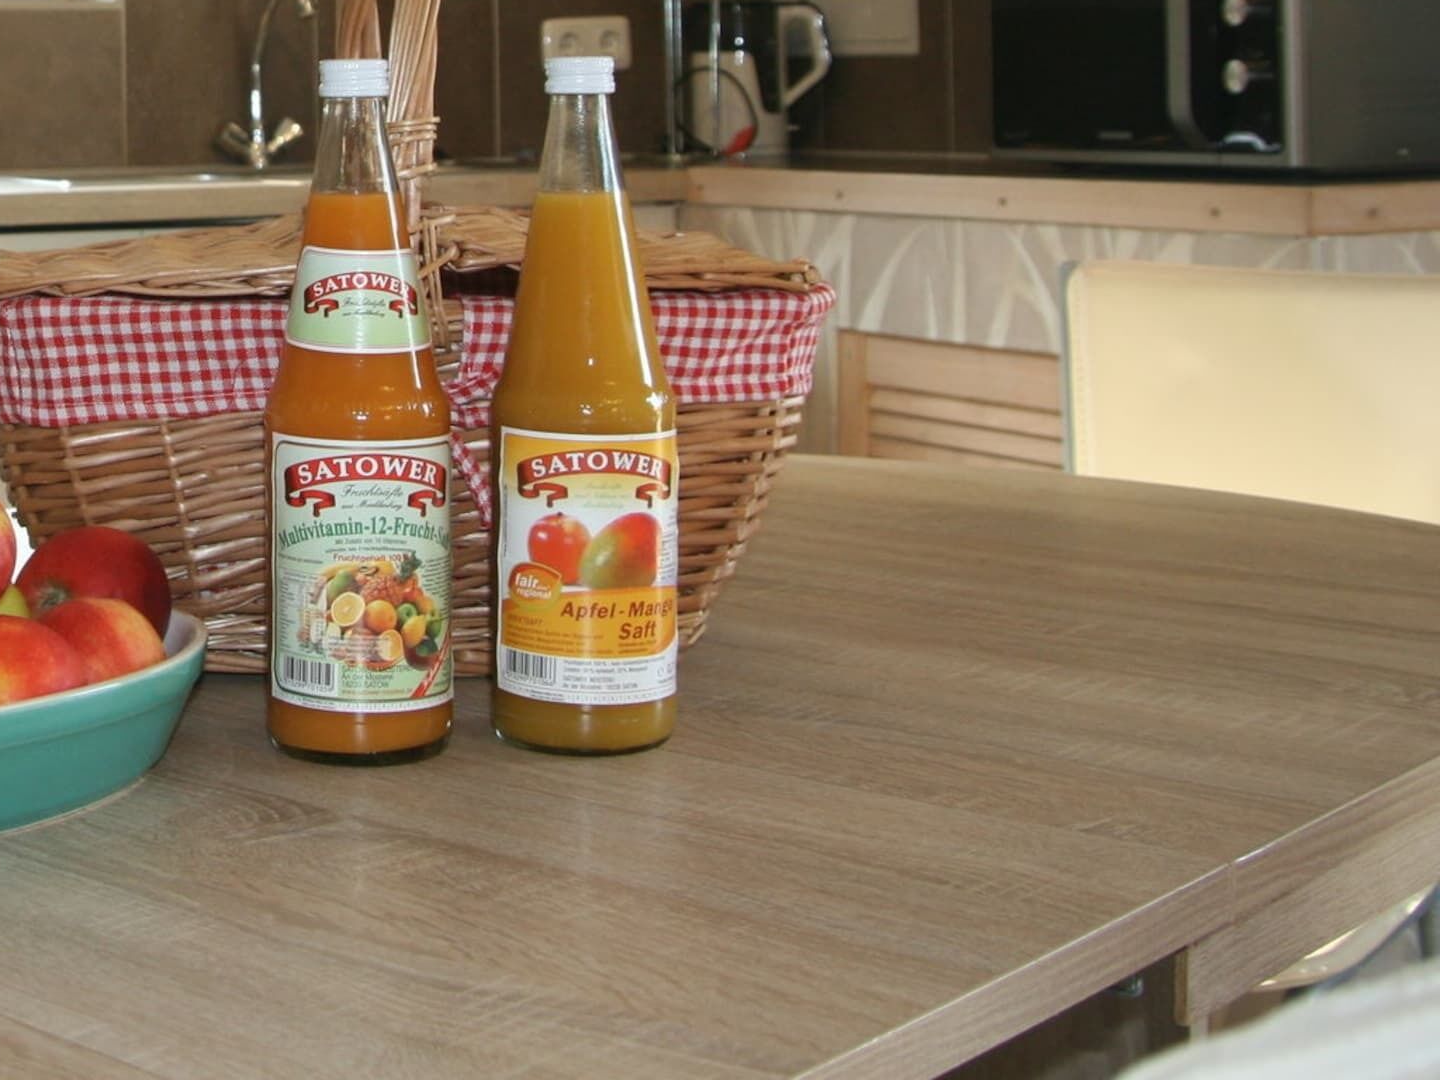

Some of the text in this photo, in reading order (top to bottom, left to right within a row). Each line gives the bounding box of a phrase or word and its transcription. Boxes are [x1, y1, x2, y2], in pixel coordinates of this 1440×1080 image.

[312, 273, 410, 298] SATOWER
[297, 456, 437, 485] SATOWER
[532, 451, 664, 478] SATOWER
[515, 572, 539, 589] fair
[561, 601, 616, 621] Apfel
[618, 620, 657, 641] Saft
